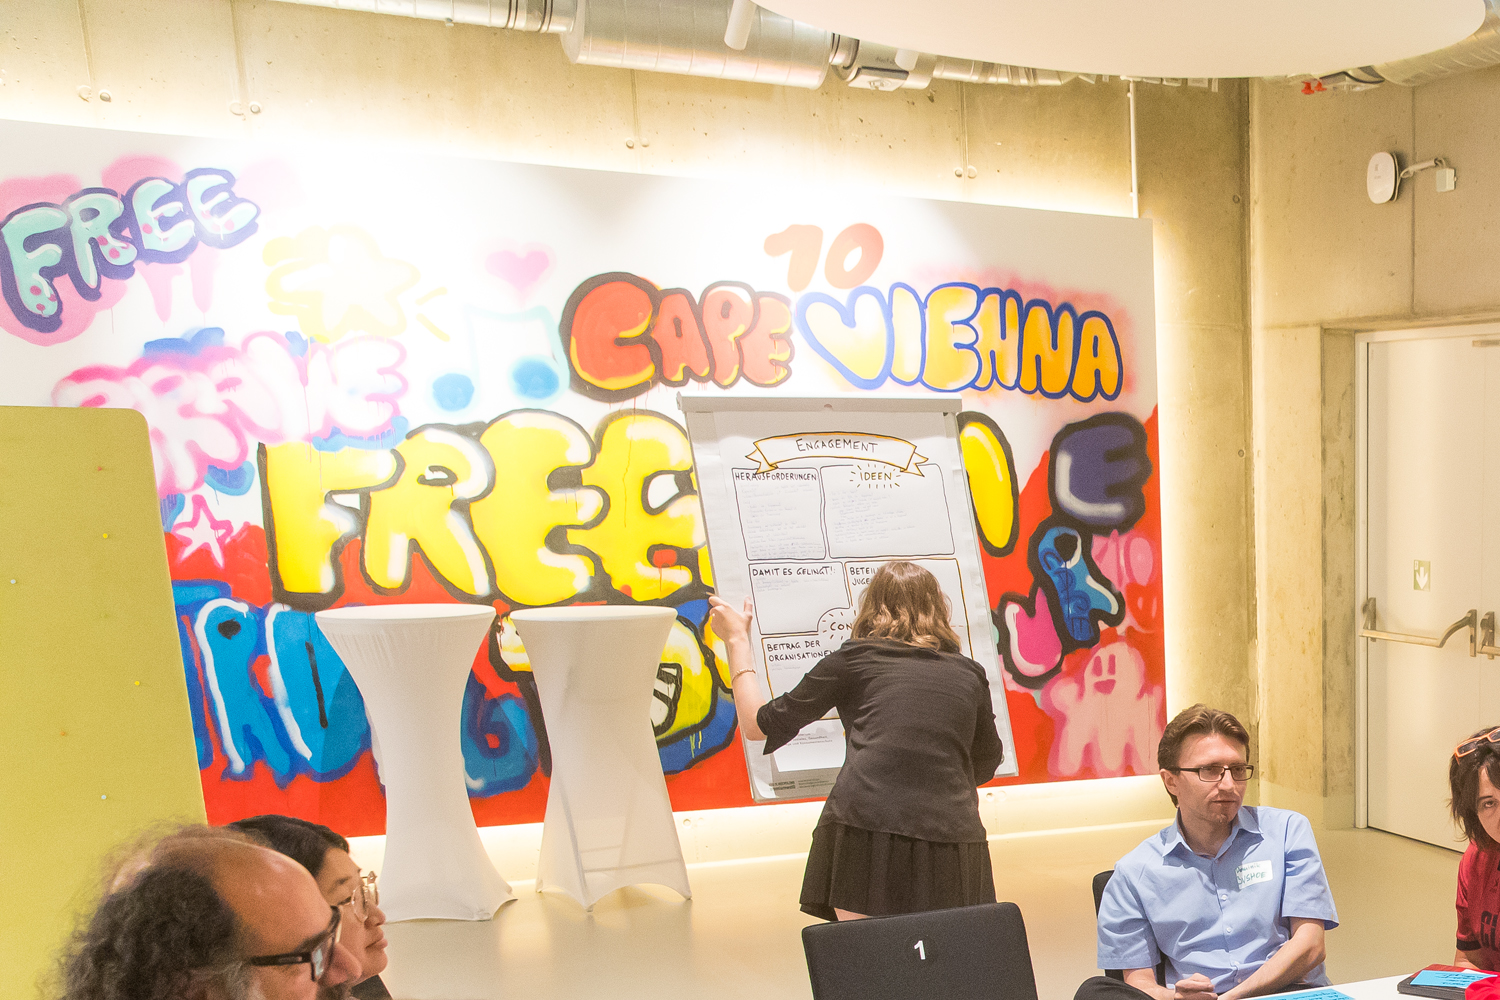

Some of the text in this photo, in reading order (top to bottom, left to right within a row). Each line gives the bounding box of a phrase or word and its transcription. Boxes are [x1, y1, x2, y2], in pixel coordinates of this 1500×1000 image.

[0, 167, 260, 333] FREE
[763, 222, 885, 293] 10
[559, 271, 1124, 403] CAPE VIENNA
[795, 438, 878, 454] ENGAGEMENT
[735, 471, 817, 482] HERAUSFORDERUNGEN
[860, 470, 892, 481] IDEEN
[752, 568, 780, 576] DAMIT
[783, 567, 793, 576] ES
[766, 640, 821, 652] BEITRAG DER
[913, 939, 926, 960] 1
